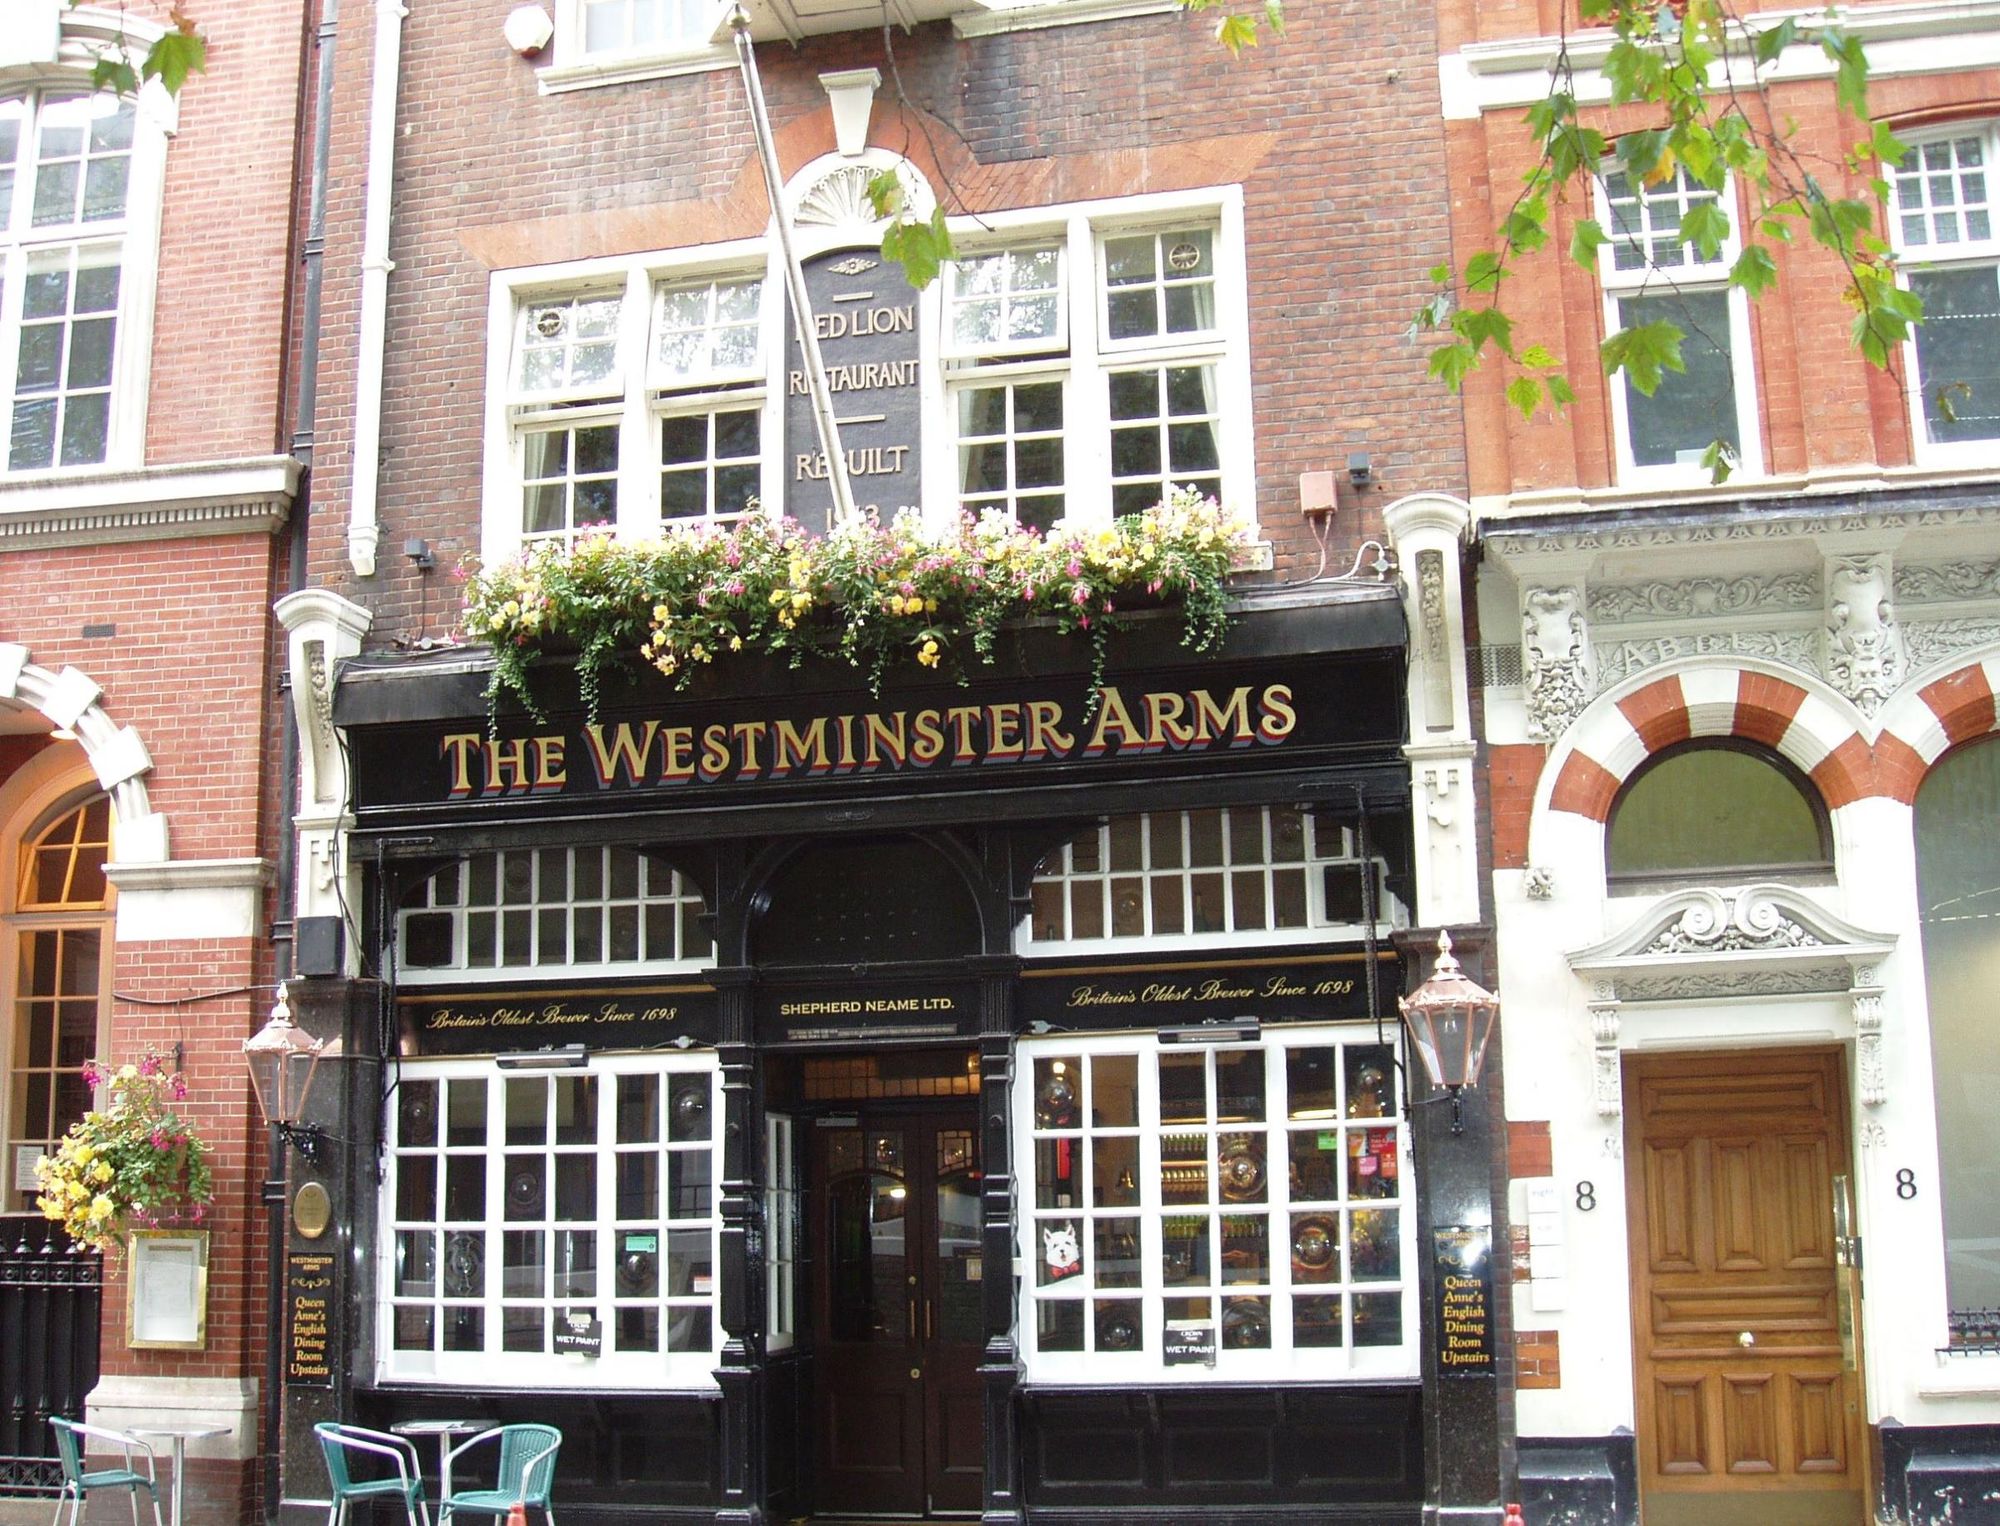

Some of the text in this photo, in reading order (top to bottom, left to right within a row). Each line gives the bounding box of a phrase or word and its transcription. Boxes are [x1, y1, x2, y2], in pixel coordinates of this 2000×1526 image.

[795, 305, 914, 341] ED LION
[789, 360, 919, 395] RTAURANT
[796, 445, 909, 480] REUILT
[441, 684, 1297, 798] THE WESTMINSTER ARMS
[1066, 976, 1355, 1007] Britain's Oldest Brewer Since 1698
[781, 998, 955, 1015] SHEPHERD NEAME LTD.
[426, 1003, 678, 1028] Britain's Oldest Brewer Since 1698
[1896, 1168, 1917, 1200] 8
[1575, 1180, 1596, 1211] 8
[1445, 1276, 1482, 1289] Queen
[295, 1296, 325, 1308] Queen
[1444, 1291, 1483, 1303] Anne's
[294, 1310, 326, 1321] Anne's
[1443, 1306, 1485, 1320] English
[293, 1323, 327, 1337] English
[1445, 1321, 1485, 1334] Dining
[294, 1336, 325, 1350] Dining
[556, 1335, 601, 1345] WET PAINT
[1449, 1335, 1482, 1348] Room
[296, 1350, 322, 1361] Room
[1165, 1345, 1215, 1353] WET PAINT
[1441, 1351, 1490, 1364] Upstairs
[290, 1364, 328, 1376] Upstairs
